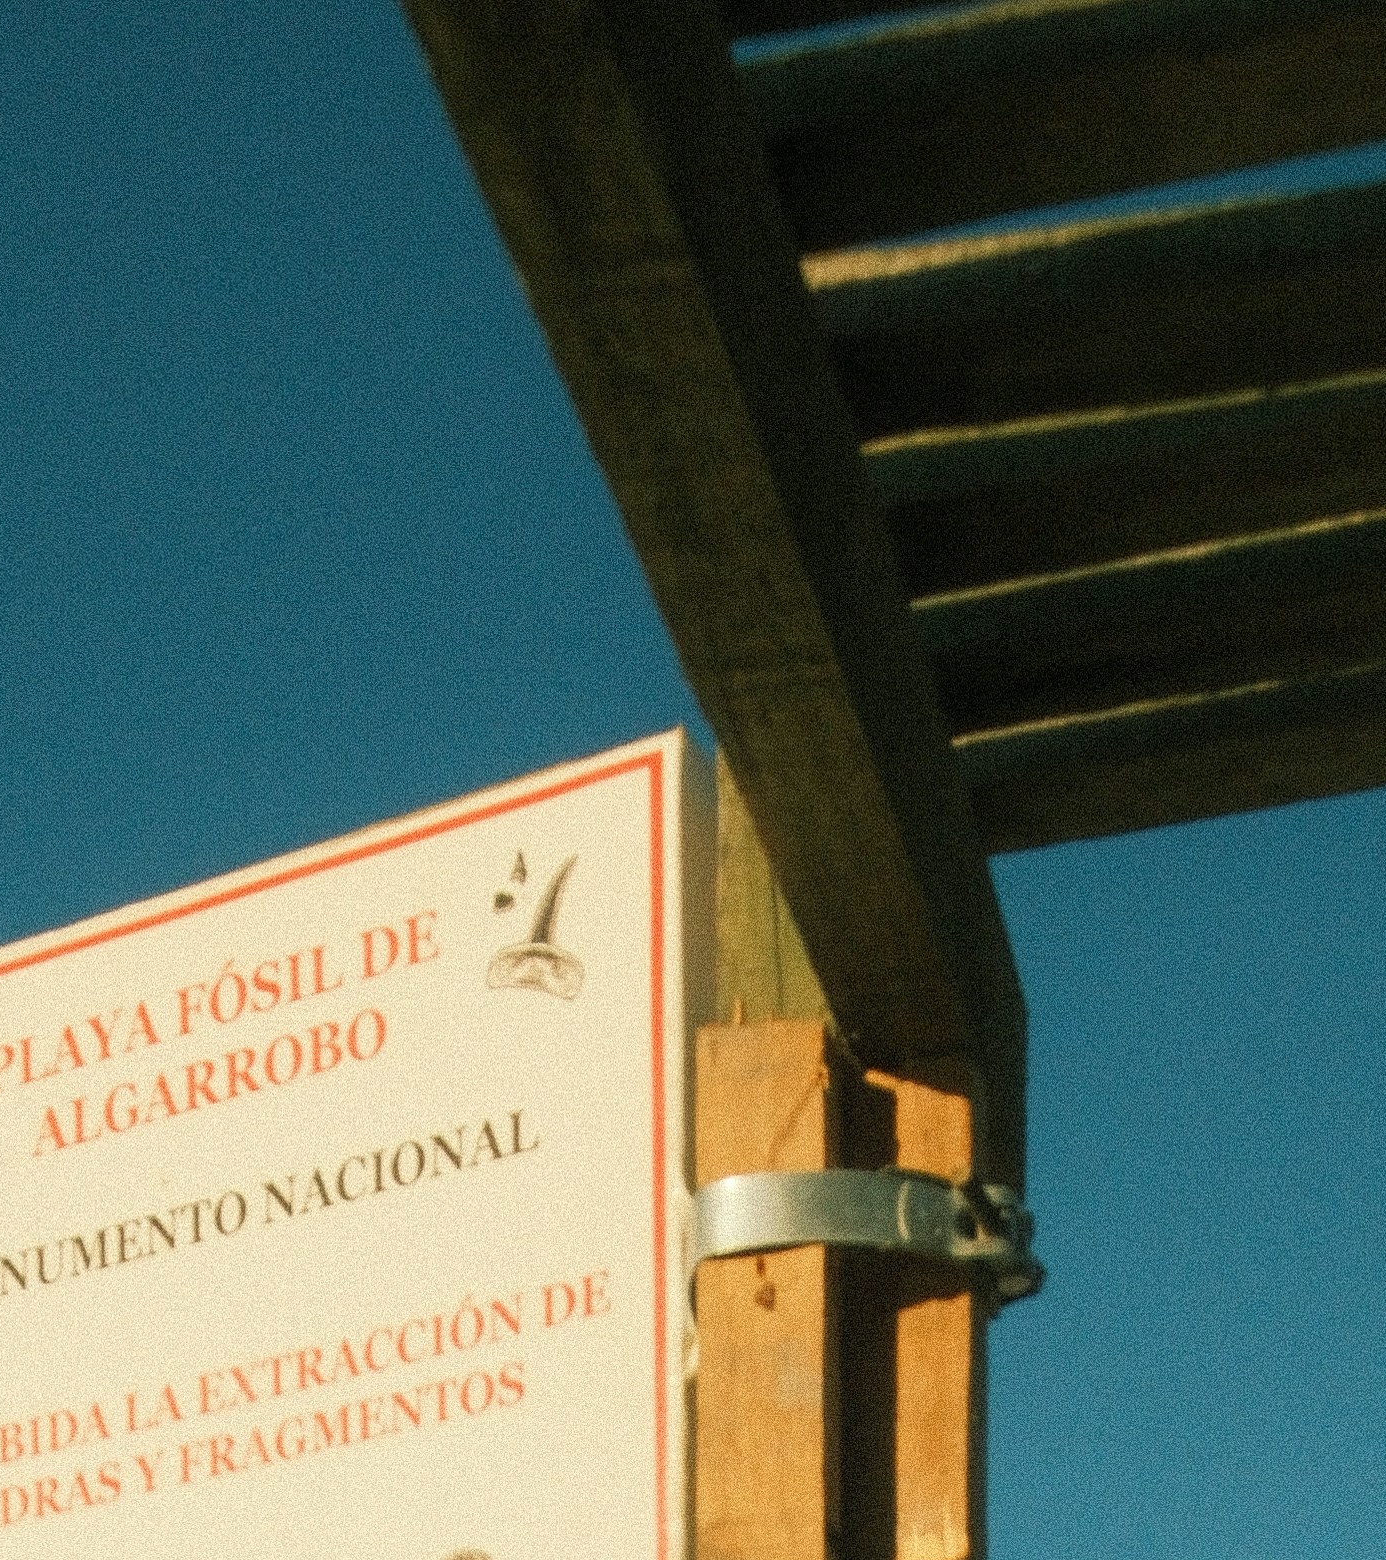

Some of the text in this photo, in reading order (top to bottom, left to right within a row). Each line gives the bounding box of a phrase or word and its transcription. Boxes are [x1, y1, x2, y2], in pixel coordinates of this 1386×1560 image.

[176, 945, 344, 1036] FÓSIL
[360, 910, 440, 980] DE
[33, 1008, 389, 1158] ALGARROBO
[263, 1110, 539, 1223] NACIONAL
[124, 1382, 184, 1433] LA
[198, 1296, 523, 1415] EXTRACCIÓN
[542, 1271, 611, 1328] DE
[135, 1449, 164, 1492] Y
[179, 1363, 527, 1484] FRAGMENTOS
